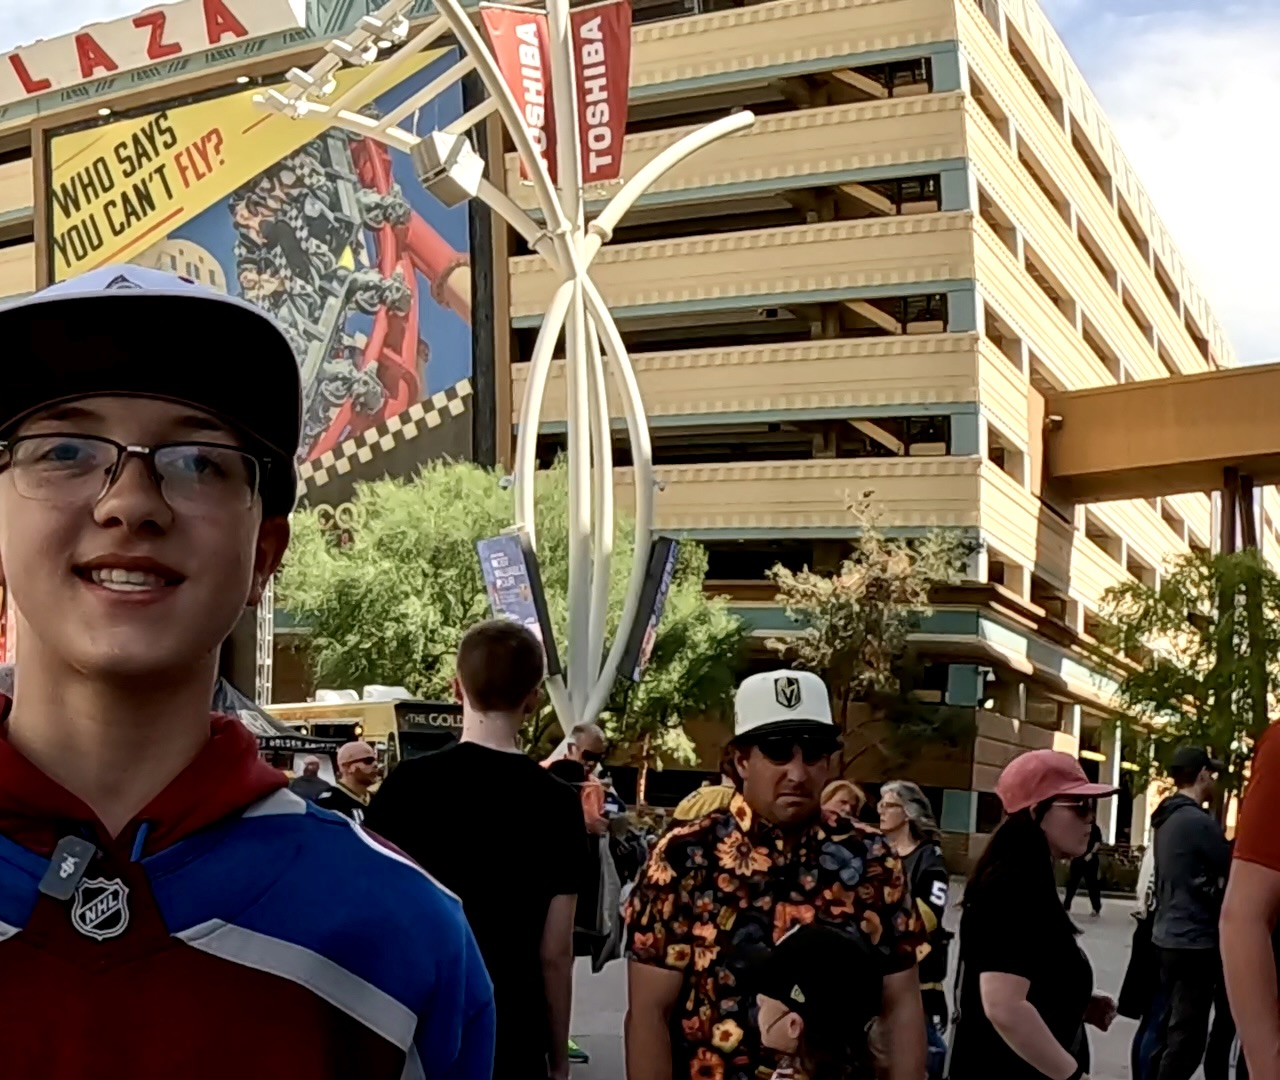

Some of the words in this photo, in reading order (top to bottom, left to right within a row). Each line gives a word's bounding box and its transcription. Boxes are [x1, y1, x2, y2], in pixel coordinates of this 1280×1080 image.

[515, 22, 548, 170] OSHIBA
[579, 15, 613, 174] TOSHIBA
[52, 156, 115, 220] WHO
[113, 111, 178, 179] SAYS
[53, 213, 104, 269] YOU
[102, 163, 174, 237] CAN'T
[173, 127, 225, 189] FLY?
[84, 894, 118, 925] NHL
[929, 879, 948, 906] 5
